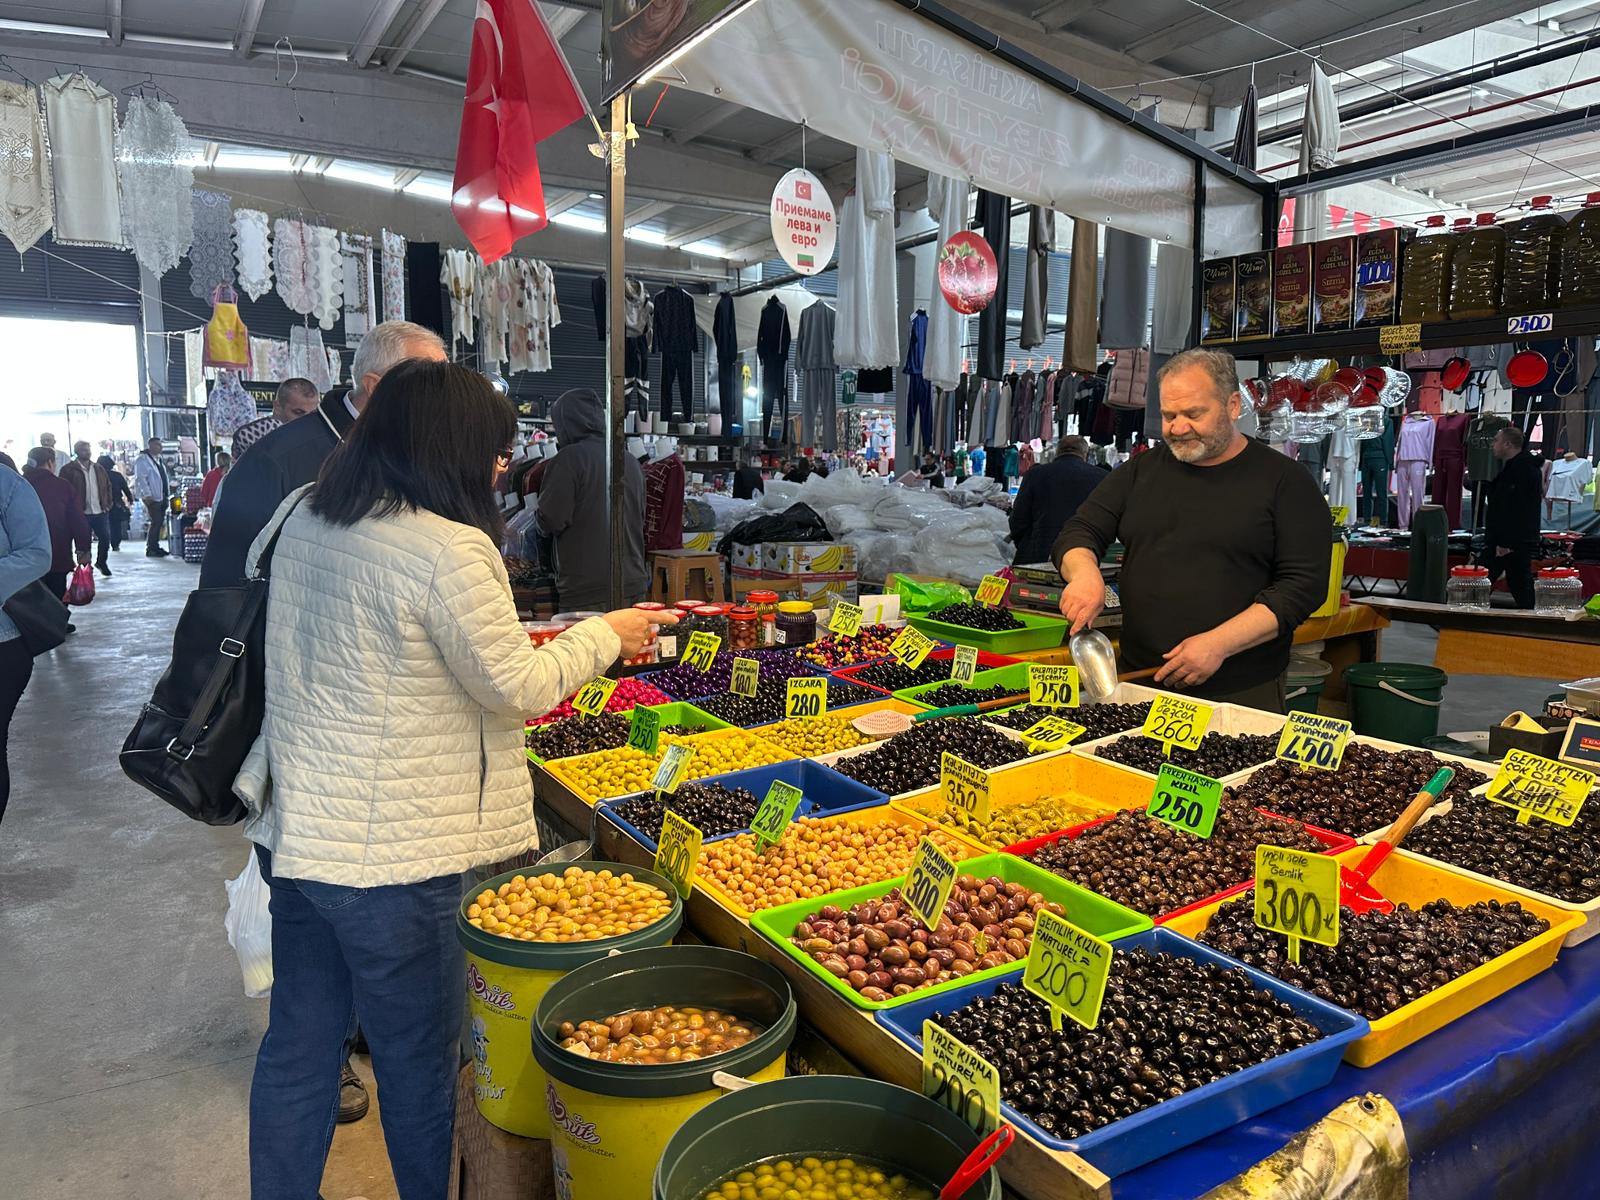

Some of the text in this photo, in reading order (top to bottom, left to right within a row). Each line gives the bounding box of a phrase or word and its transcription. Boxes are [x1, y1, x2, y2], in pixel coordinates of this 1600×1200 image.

[775, 197, 831, 222] Приемаме
[787, 218, 821, 233] лева и
[791, 233, 818, 248] евро
[1358, 261, 1392, 285] 1000
[1508, 315, 1551, 334] 2500
[845, 382, 855, 394] 10
[980, 584, 1001, 600] 300
[833, 614, 856, 632] 250
[686, 646, 713, 671] 250
[893, 639, 919, 665] 250
[735, 673, 751, 694] 180
[1035, 681, 1072, 704] 250
[789, 693, 820, 716] 280
[1160, 696, 1198, 713] TUZSUZ
[1290, 713, 1323, 727] ERKEN
[630, 726, 653, 750] 250
[1026, 726, 1064, 743] 280
[1162, 766, 1214, 789] ERKEN HASAT
[1171, 780, 1199, 796] KIZIL
[946, 779, 977, 813] 350
[1151, 791, 1203, 828] 250
[666, 815, 696, 841] BODRUM
[658, 833, 691, 884] 300
[1270, 865, 1304, 882] Gemlik
[906, 867, 939, 919] 300
[1074, 933, 1103, 958] KIZIL
[1033, 951, 1088, 1007] 200
[929, 1026, 993, 1084] TAZE KIRMA
[933, 1046, 977, 1085] NATUREL
[932, 1061, 985, 1136] 200
